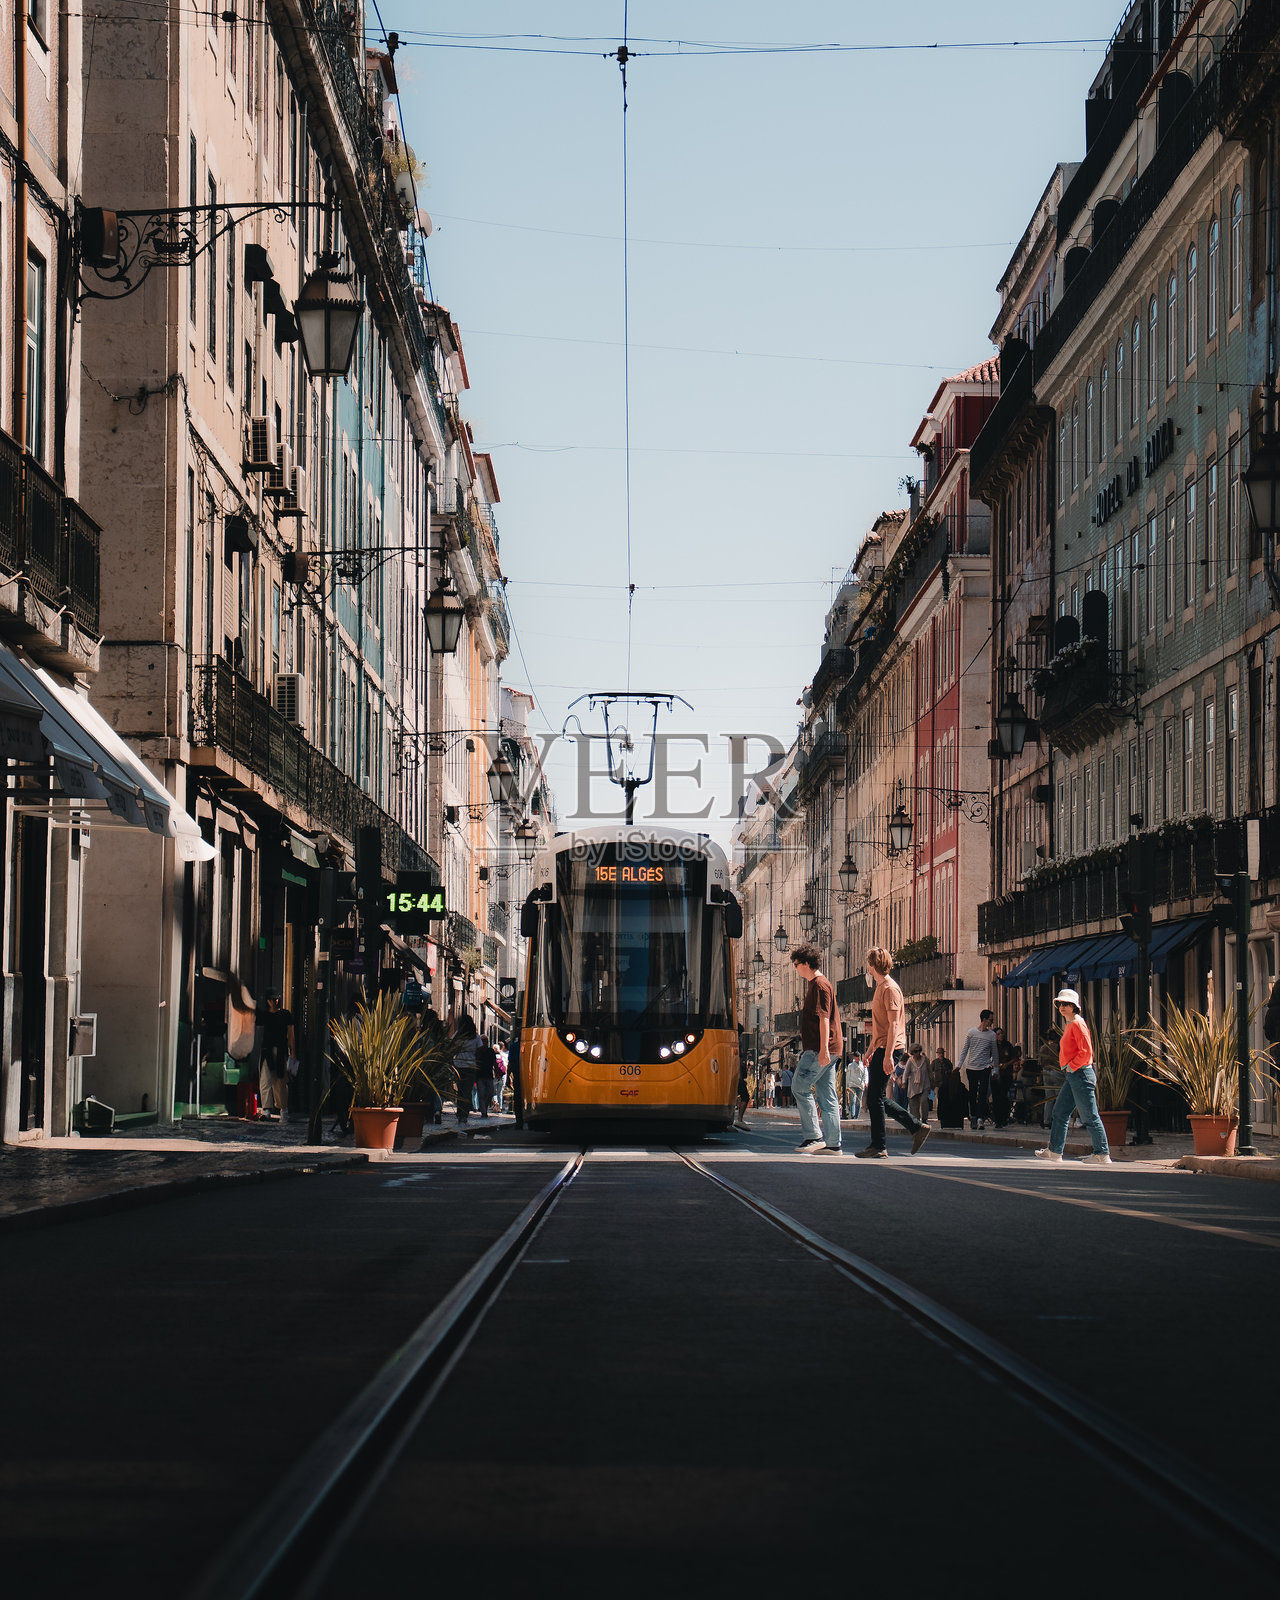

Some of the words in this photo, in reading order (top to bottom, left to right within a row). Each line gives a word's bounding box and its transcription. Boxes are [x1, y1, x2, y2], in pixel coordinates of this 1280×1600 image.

[1095, 473, 1123, 528] HOTEL
[1126, 455, 1140, 497] DA
[1144, 417, 1175, 478] BAIXA
[595, 866, 617, 881] 15E
[386, 893, 444, 912] 15:44
[619, 1065, 641, 1076] 606
